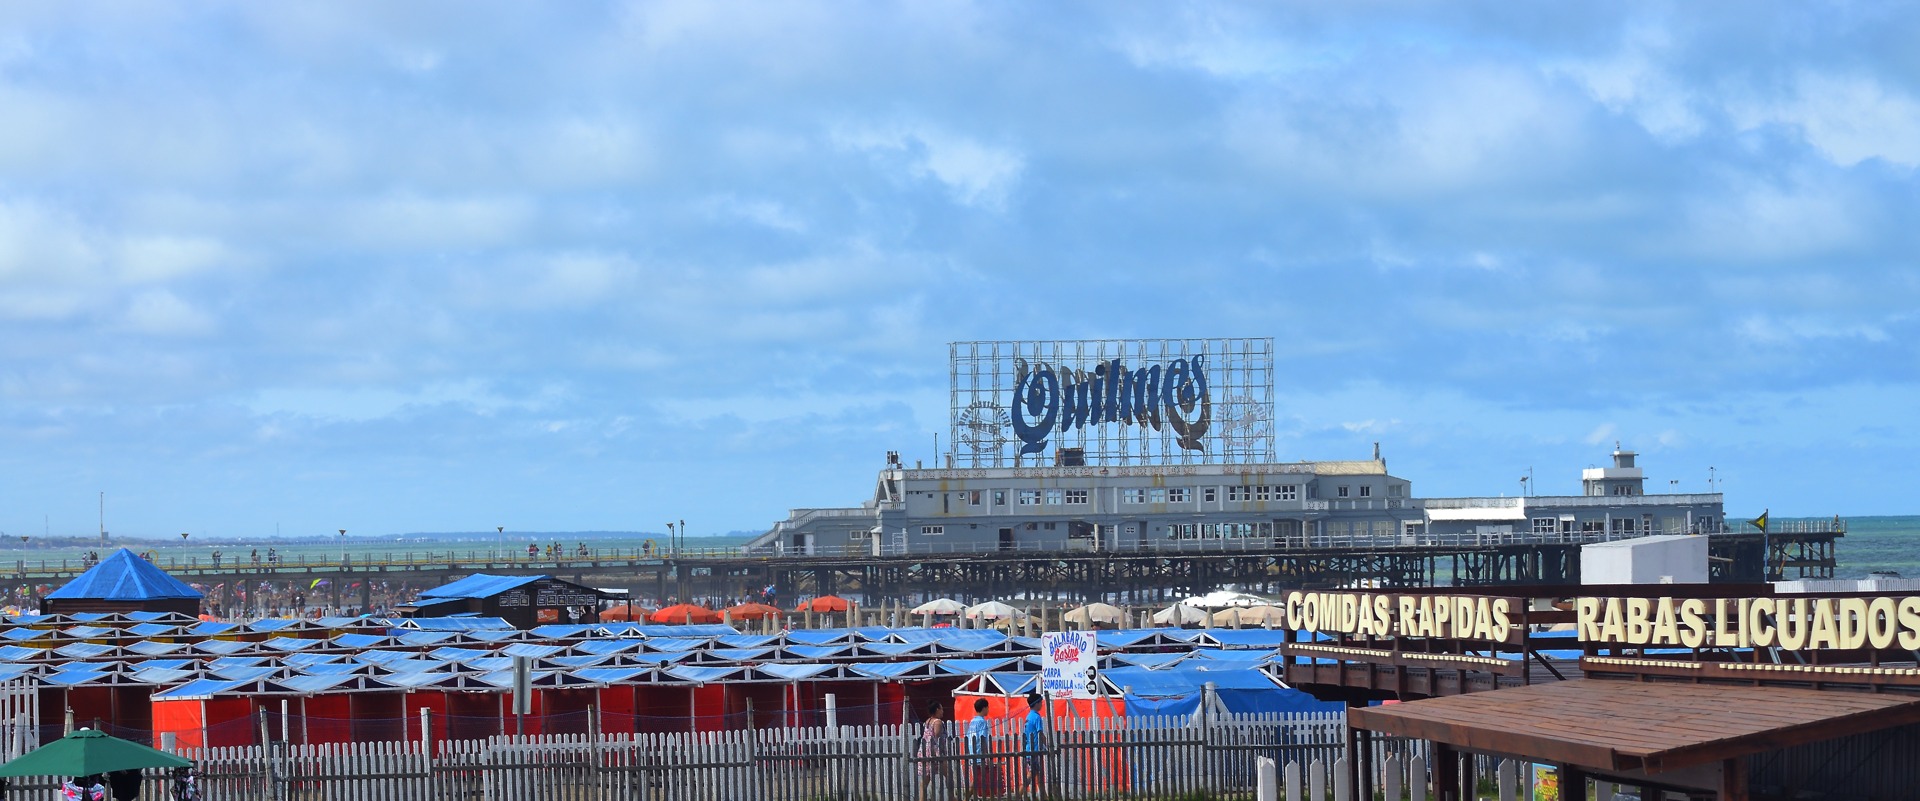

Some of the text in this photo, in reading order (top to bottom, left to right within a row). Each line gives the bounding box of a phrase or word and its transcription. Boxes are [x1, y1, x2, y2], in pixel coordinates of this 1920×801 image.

[1011, 354, 1210, 456] Quilmes
[1287, 591, 1511, 643] COMIDAS RAPIDAS
[1577, 597, 1920, 651] RABAS LICUADOS
[1049, 631, 1087, 656] BALNEARIO
[1044, 668, 1061, 678] CARPA
[1044, 679, 1073, 690] SOMBRILLA
